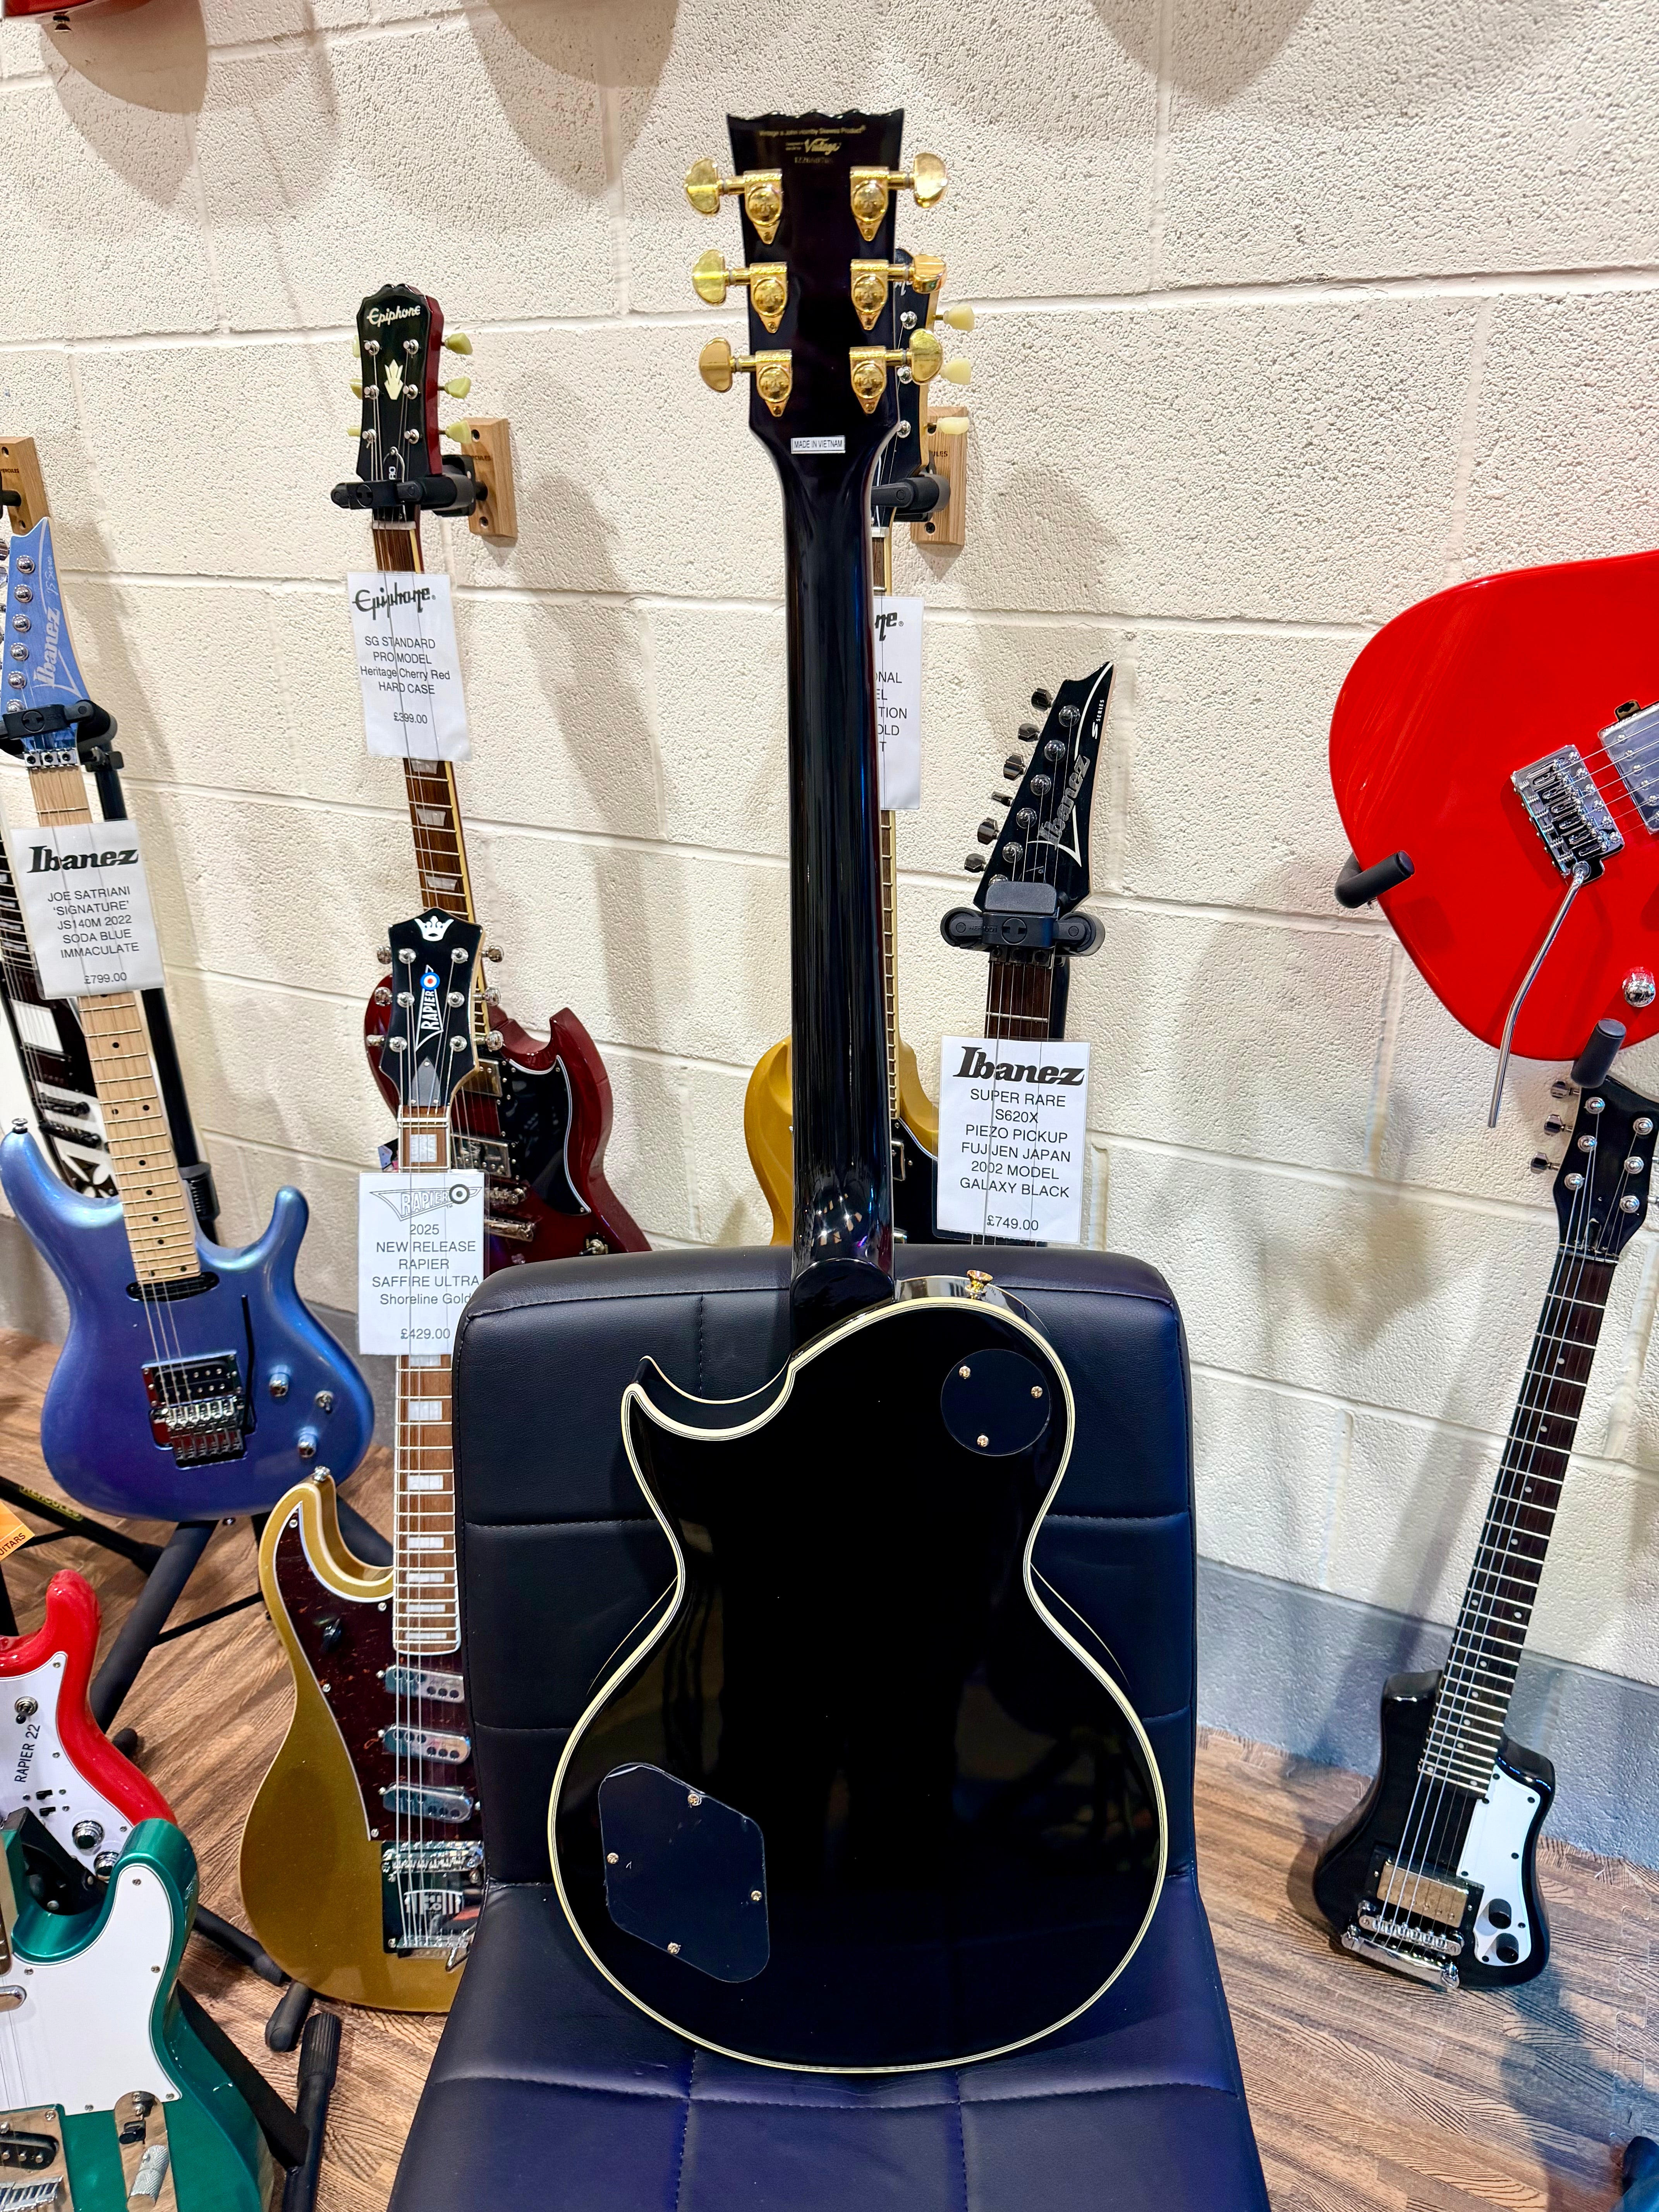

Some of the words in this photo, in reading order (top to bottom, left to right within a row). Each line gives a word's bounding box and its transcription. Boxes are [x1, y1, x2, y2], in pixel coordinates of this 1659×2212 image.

[366, 306, 421, 327] Epiphone
[352, 582, 430, 620] Epiphone
[33, 606, 60, 689] Ibanez
[365, 636, 379, 646] SG
[382, 636, 435, 649] STANDARD
[373, 652, 395, 662] PRO
[397, 653, 432, 664] MODEL
[360, 666, 397, 678] Heritage
[399, 668, 428, 681] Cherry
[431, 670, 450, 680] Red
[379, 682, 405, 692] HARD
[407, 684, 435, 694] CASE
[394, 712, 428, 724] £399.00
[1096, 700, 1104, 721] SERIES
[1037, 754, 1090, 850] Ibanez
[27, 845, 139, 873] Ibanez
[48, 891, 72, 902] JOE
[75, 886, 130, 900] SATRIANI
[58, 918, 101, 930] JS140M
[105, 915, 132, 926] 2022
[63, 933, 97, 943] SODA
[100, 929, 132, 940] BLUE
[61, 943, 139, 958] IMMACULATE
[84, 972, 127, 984] £799.00
[421, 991, 440, 1030] RAPIER
[953, 1046, 1085, 1085] Ibanez
[971, 1089, 1019, 1104] SUPER
[1025, 1094, 1066, 1107] RARE
[996, 1109, 1038, 1123] S620X
[966, 1124, 1008, 1139] PIEZO
[1013, 1129, 1068, 1143] PICKUP
[1023, 1149, 1070, 1162] JAPAN
[972, 1161, 1003, 1174] 2002
[1008, 1164, 1059, 1179] MODEL
[960, 1177, 1017, 1193] GALAXY
[1022, 1184, 1069, 1197] BLACK
[400, 1190, 449, 1216] RAPIER
[410, 1224, 440, 1235] 2025
[987, 1215, 1039, 1231] £749.00
[376, 1242, 408, 1252] NEW
[413, 1241, 476, 1252] RELEASE
[399, 1259, 449, 1269] RAPIER
[372, 1276, 430, 1287] SAFFIRE
[435, 1276, 479, 1286] ULTRA
[380, 1293, 438, 1304] Shoreline
[443, 1293, 471, 1304] Gold
[400, 1328, 450, 1339] £429.00
[0, 1533, 26, 1556] UITARS
[14, 1743, 35, 1783] RAPIER
[25, 1724, 40, 1739] 22
